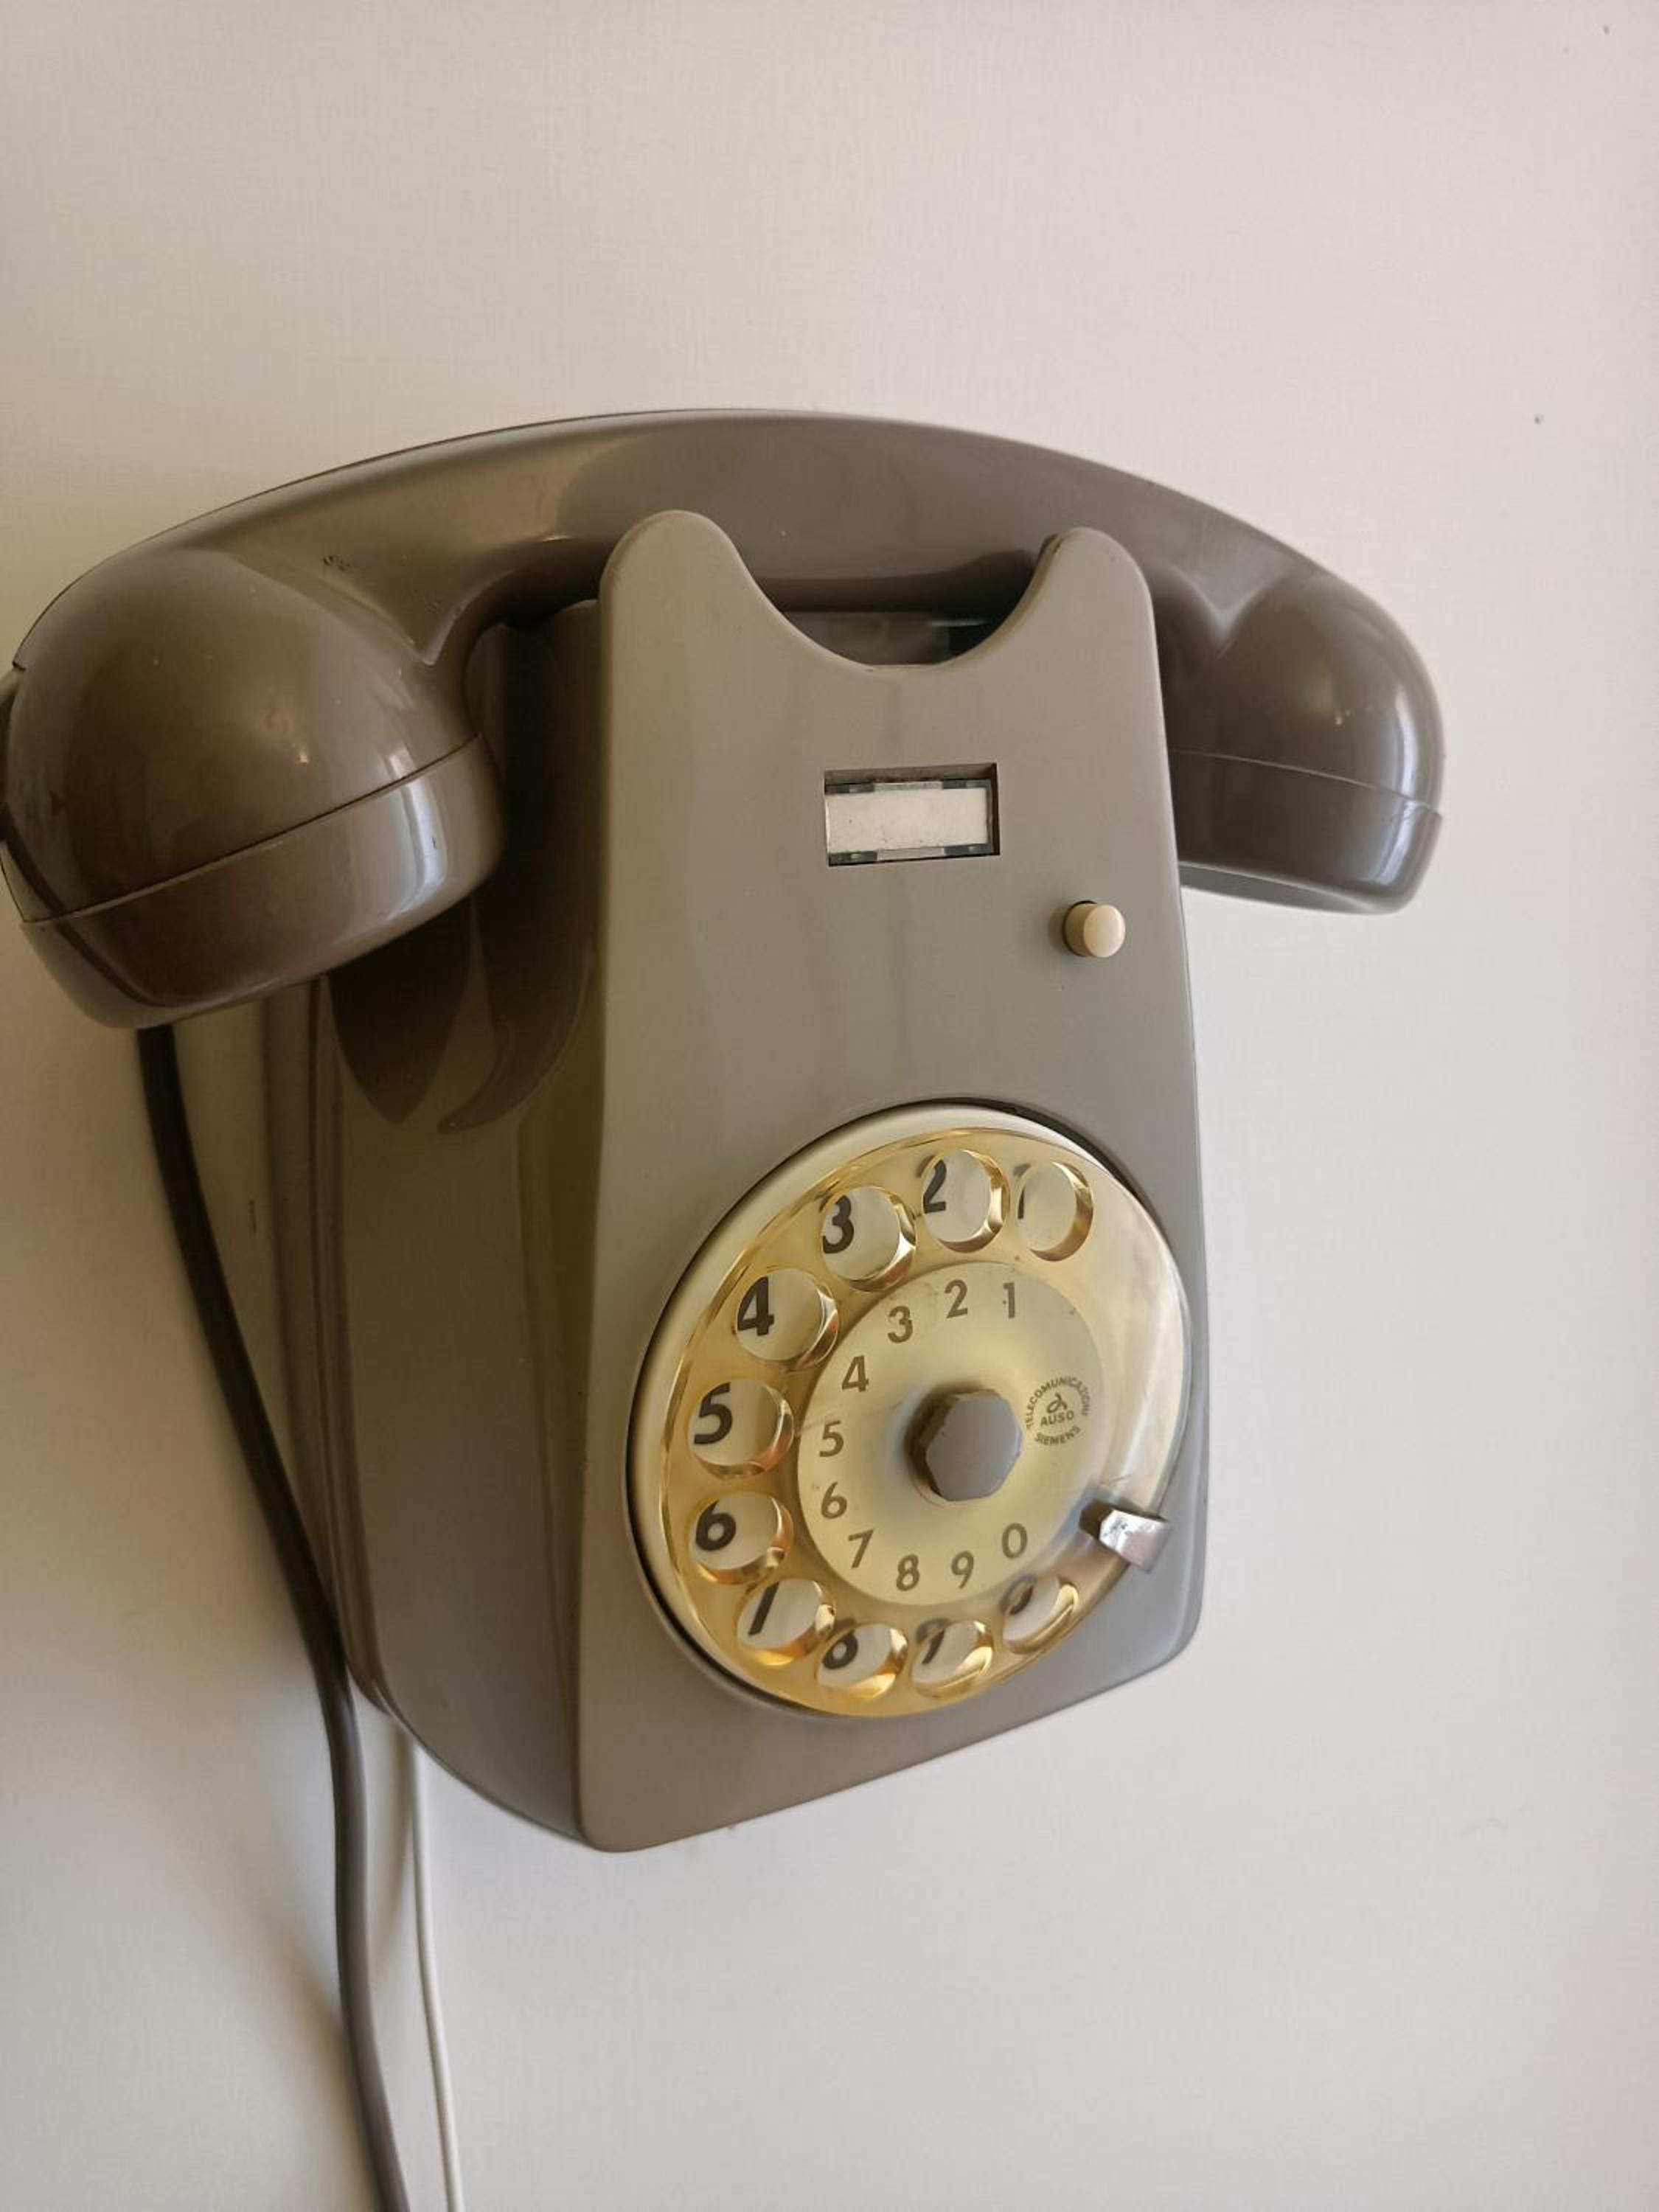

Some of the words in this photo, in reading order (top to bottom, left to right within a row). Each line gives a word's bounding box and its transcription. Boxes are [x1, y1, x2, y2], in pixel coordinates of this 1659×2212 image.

[917, 1154, 947, 1214] 2
[819, 1194, 855, 1254] 3
[736, 1276, 775, 1336] 4
[944, 1279, 968, 1319] 2
[1003, 1281, 1016, 1318] 1
[887, 1305, 914, 1344] 3
[841, 1354, 870, 1393] 4
[693, 1381, 734, 1445] 5
[818, 1419, 845, 1458] 5
[1034, 1425, 1081, 1445] SIEMENS
[820, 1481, 848, 1520] 6
[695, 1499, 737, 1551] 6
[1001, 1522, 1029, 1559] 0
[847, 1528, 874, 1570] 7
[896, 1553, 921, 1592] 8
[950, 1550, 975, 1590] 9
